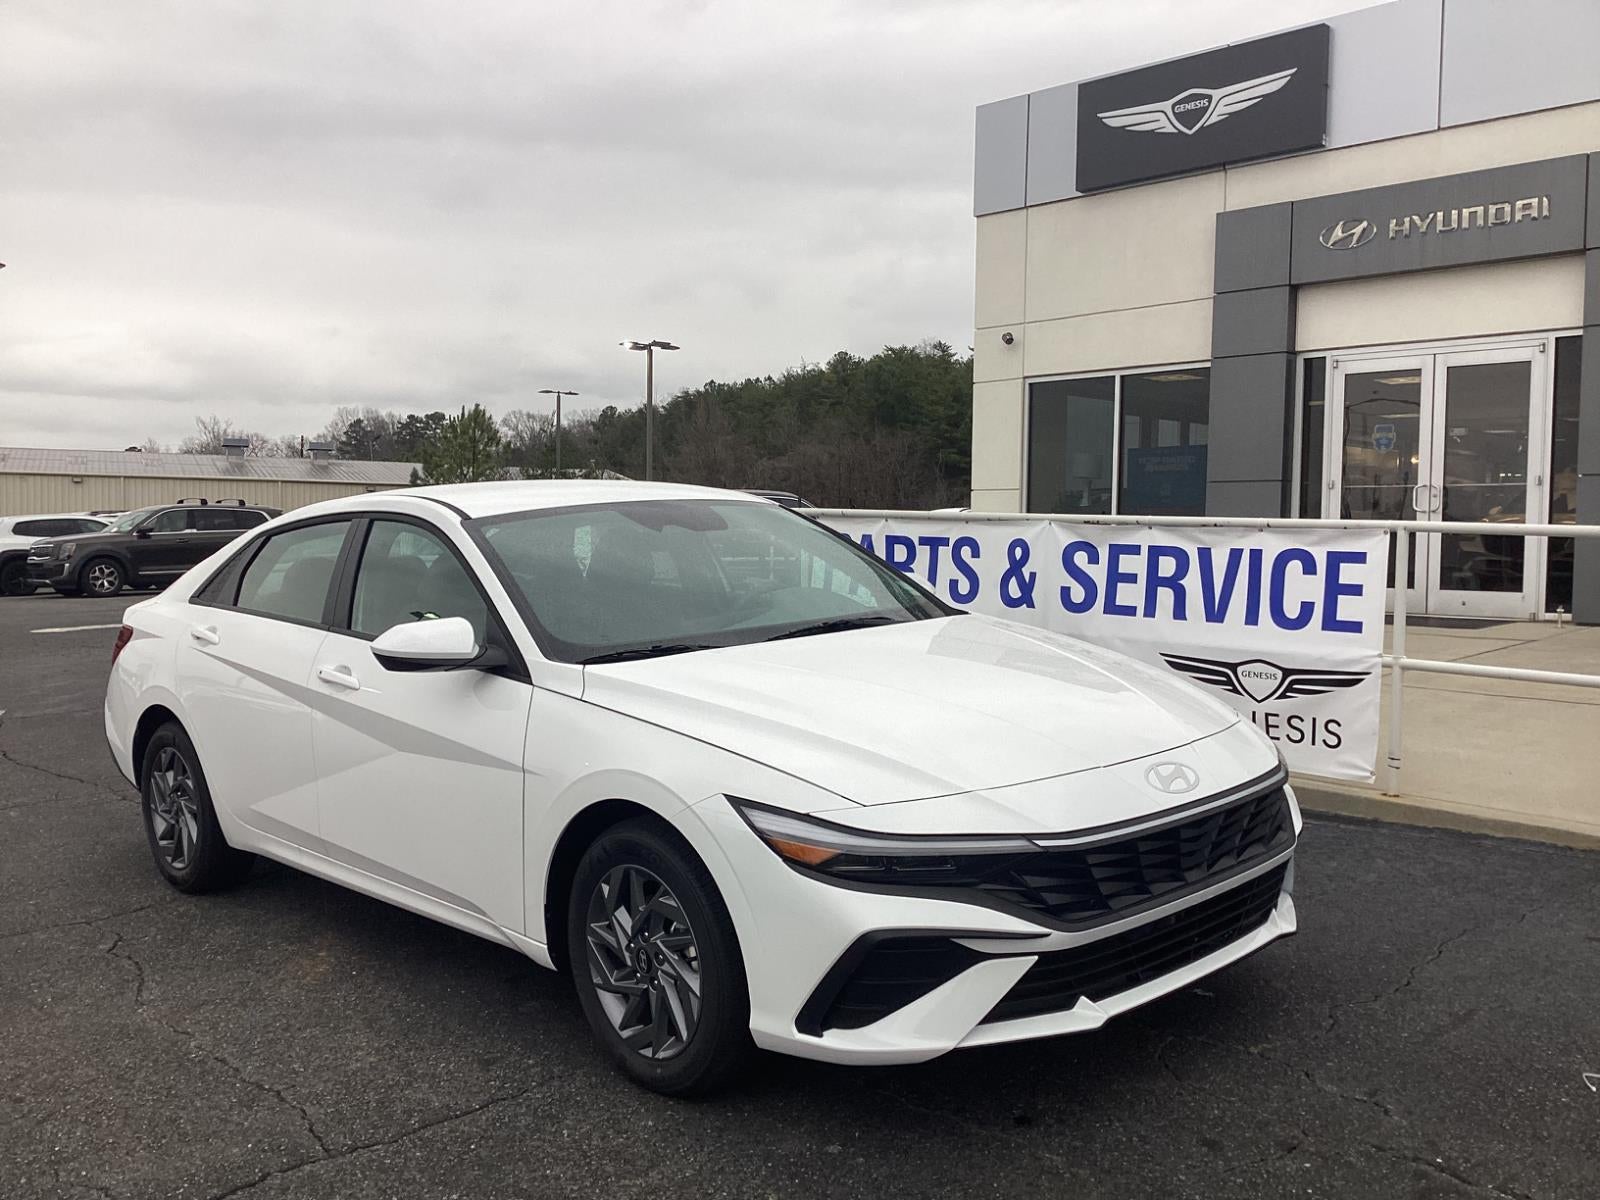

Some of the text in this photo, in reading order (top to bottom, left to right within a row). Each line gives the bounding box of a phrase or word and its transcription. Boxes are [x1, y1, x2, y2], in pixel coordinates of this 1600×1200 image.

[1174, 98, 1209, 113] GENESIS
[1388, 196, 1550, 240] HYUNDAI
[841, 533, 1368, 634] RTS & SERVICE
[1241, 670, 1278, 681] GENESIS
[1251, 710, 1342, 749] ESIS
